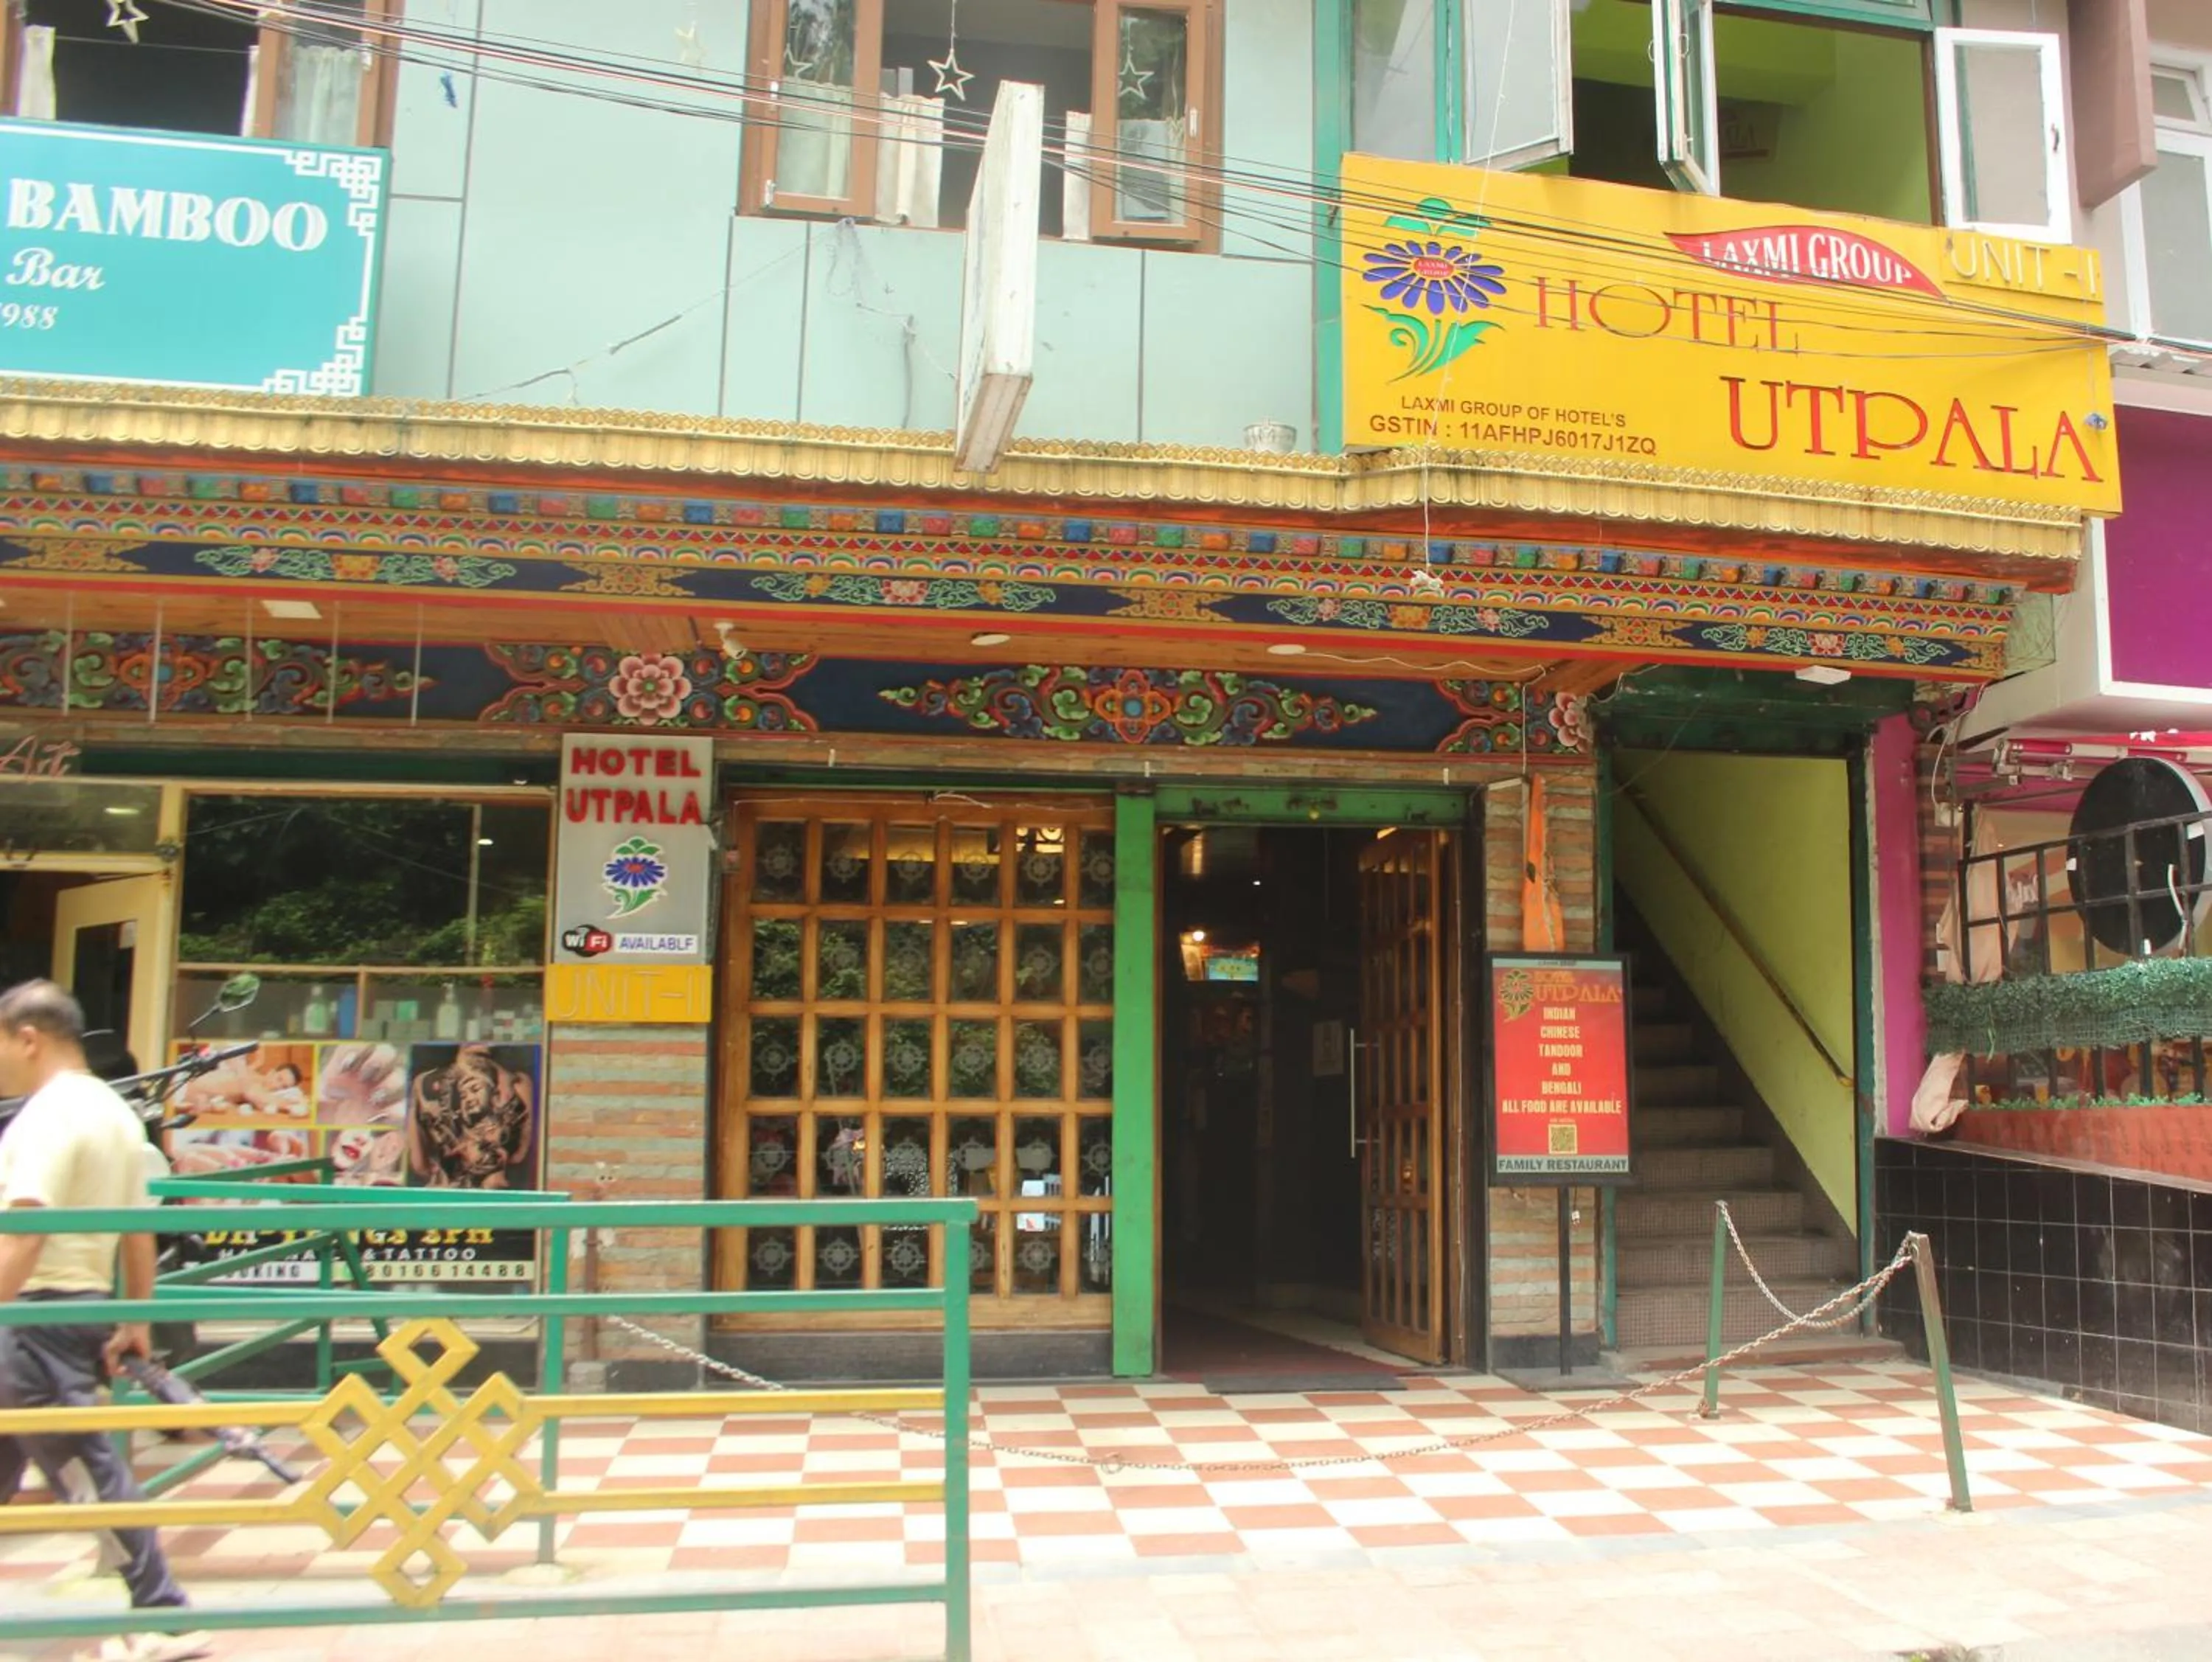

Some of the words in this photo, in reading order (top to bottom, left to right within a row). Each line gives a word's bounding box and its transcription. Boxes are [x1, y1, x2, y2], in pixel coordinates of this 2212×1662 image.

[7, 178, 328, 252] BAMBOO
[5, 247, 106, 291] Bar
[1703, 233, 1801, 275] LAXMI
[1808, 232, 1913, 284] GROUP
[1950, 237, 2051, 290] UNIT
[0, 302, 59, 330] 988
[1534, 276, 1799, 358] HOTEL
[1369, 414, 1438, 437] GSTIN
[1402, 395, 1455, 413] LAXMI
[1461, 400, 1523, 418] GROUP
[1527, 406, 1550, 421] OF
[1556, 409, 1627, 428] HOTEL'S
[1719, 375, 2104, 483] UTPALA
[571, 747, 702, 778] HOTEL
[565, 787, 703, 825] UTPALA
[1540, 1026, 1580, 1039] CHINESE
[1539, 1043, 1583, 1057] TANDOOR
[1551, 1063, 1571, 1077] AND
[1542, 1081, 1582, 1095] BENGALI
[1502, 1100, 1519, 1113] ALL
[1521, 1100, 1547, 1114] FOOD
[1549, 1100, 1568, 1113] ARE
[1570, 1100, 1621, 1114] AVAILABLE
[1498, 1159, 1545, 1170] FAMILY
[1548, 1159, 1627, 1171] RESTAURANT
[383, 1248, 476, 1261] TATTOO
